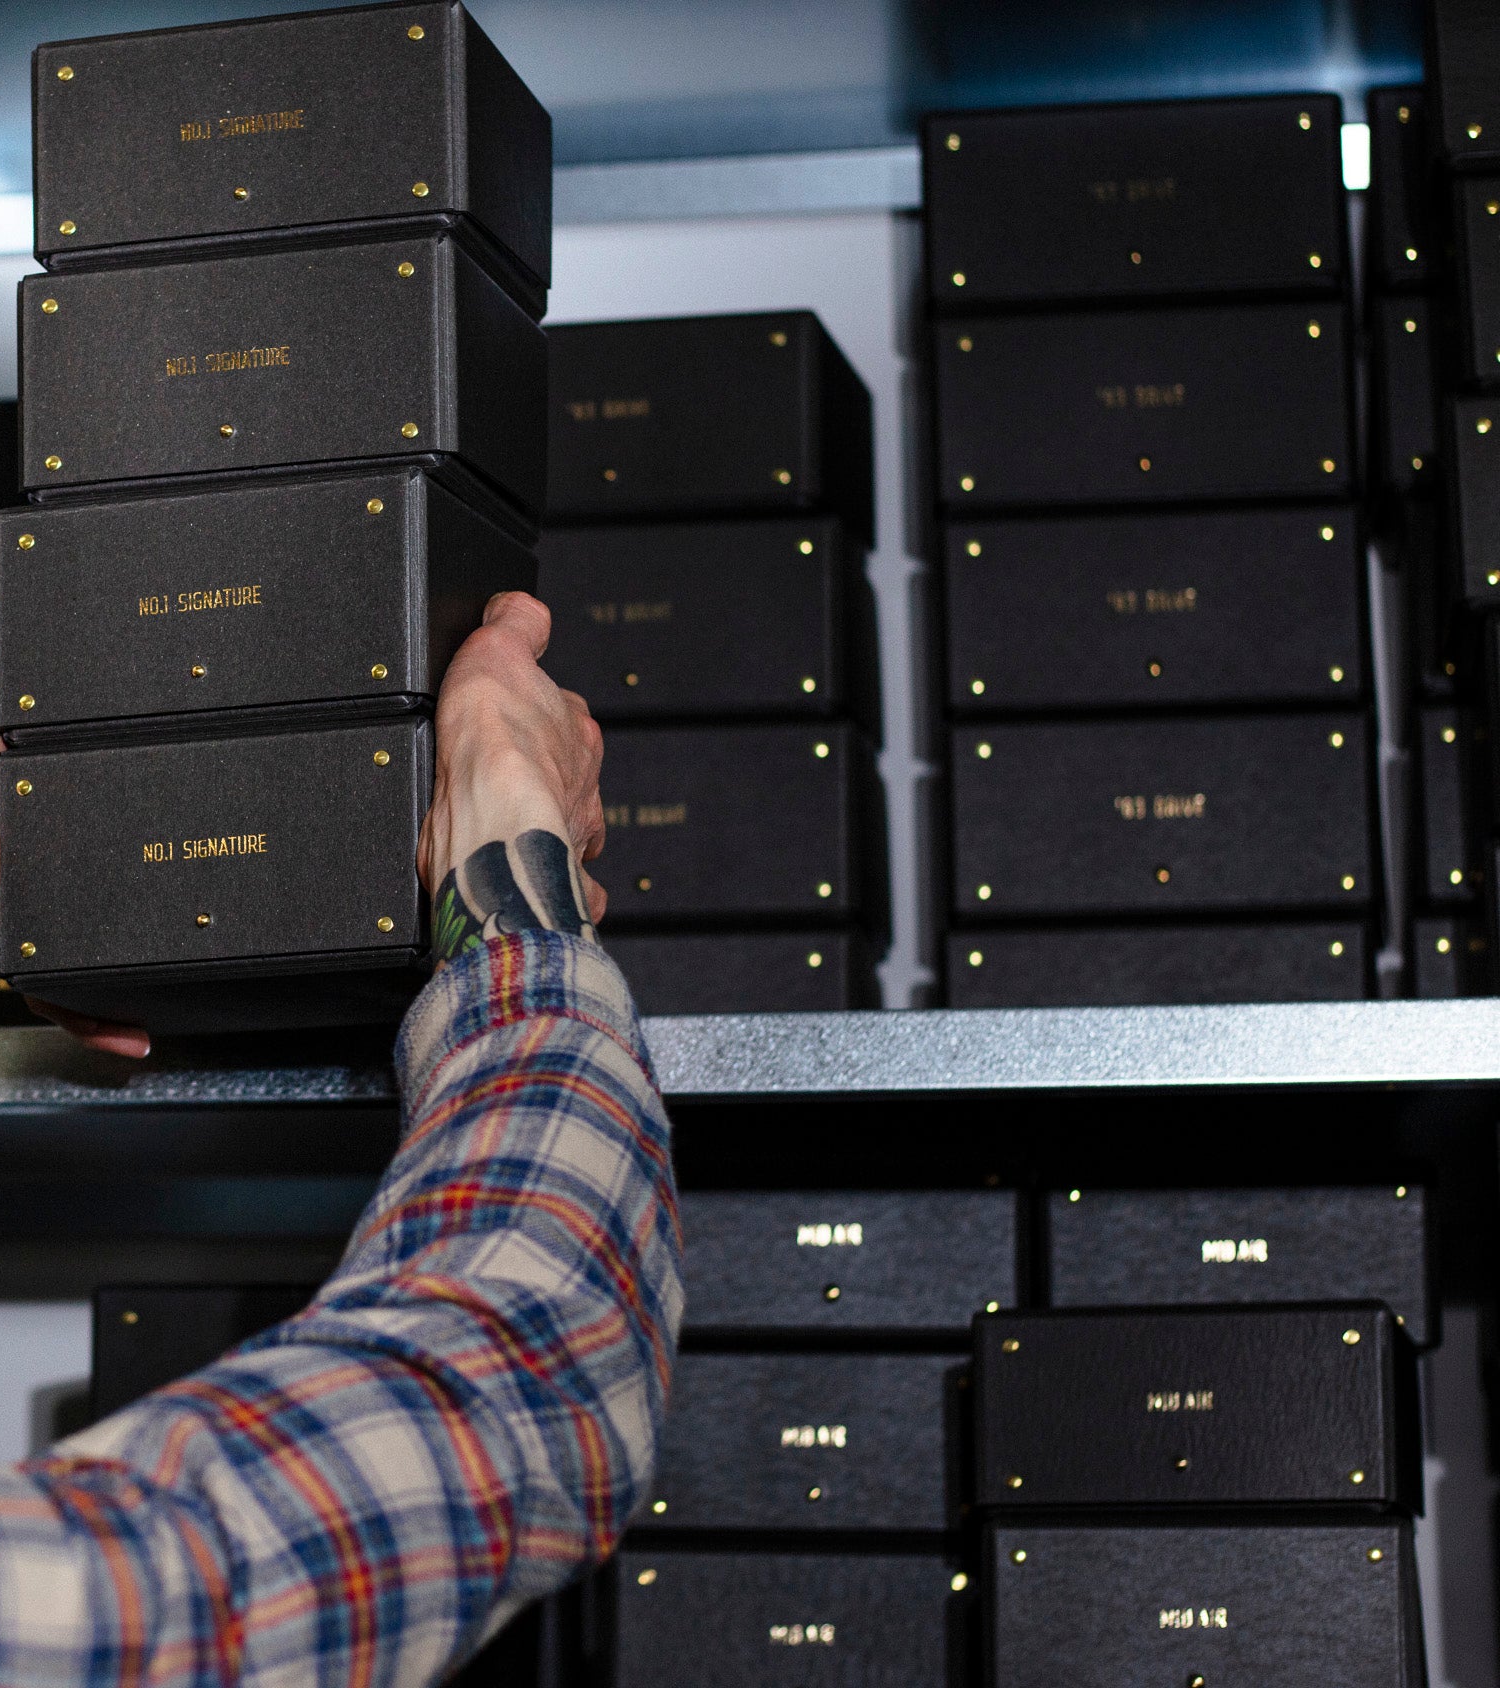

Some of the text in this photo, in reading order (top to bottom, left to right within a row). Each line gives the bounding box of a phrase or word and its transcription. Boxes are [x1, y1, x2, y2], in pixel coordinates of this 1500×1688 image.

[180, 108, 305, 142] NO.1 SIGNATURE
[165, 345, 291, 378] NO.1 SIGNATURE
[139, 585, 263, 617] NO.1 SIGNATURE
[143, 833, 268, 863] NO.1 SIGNATURE
